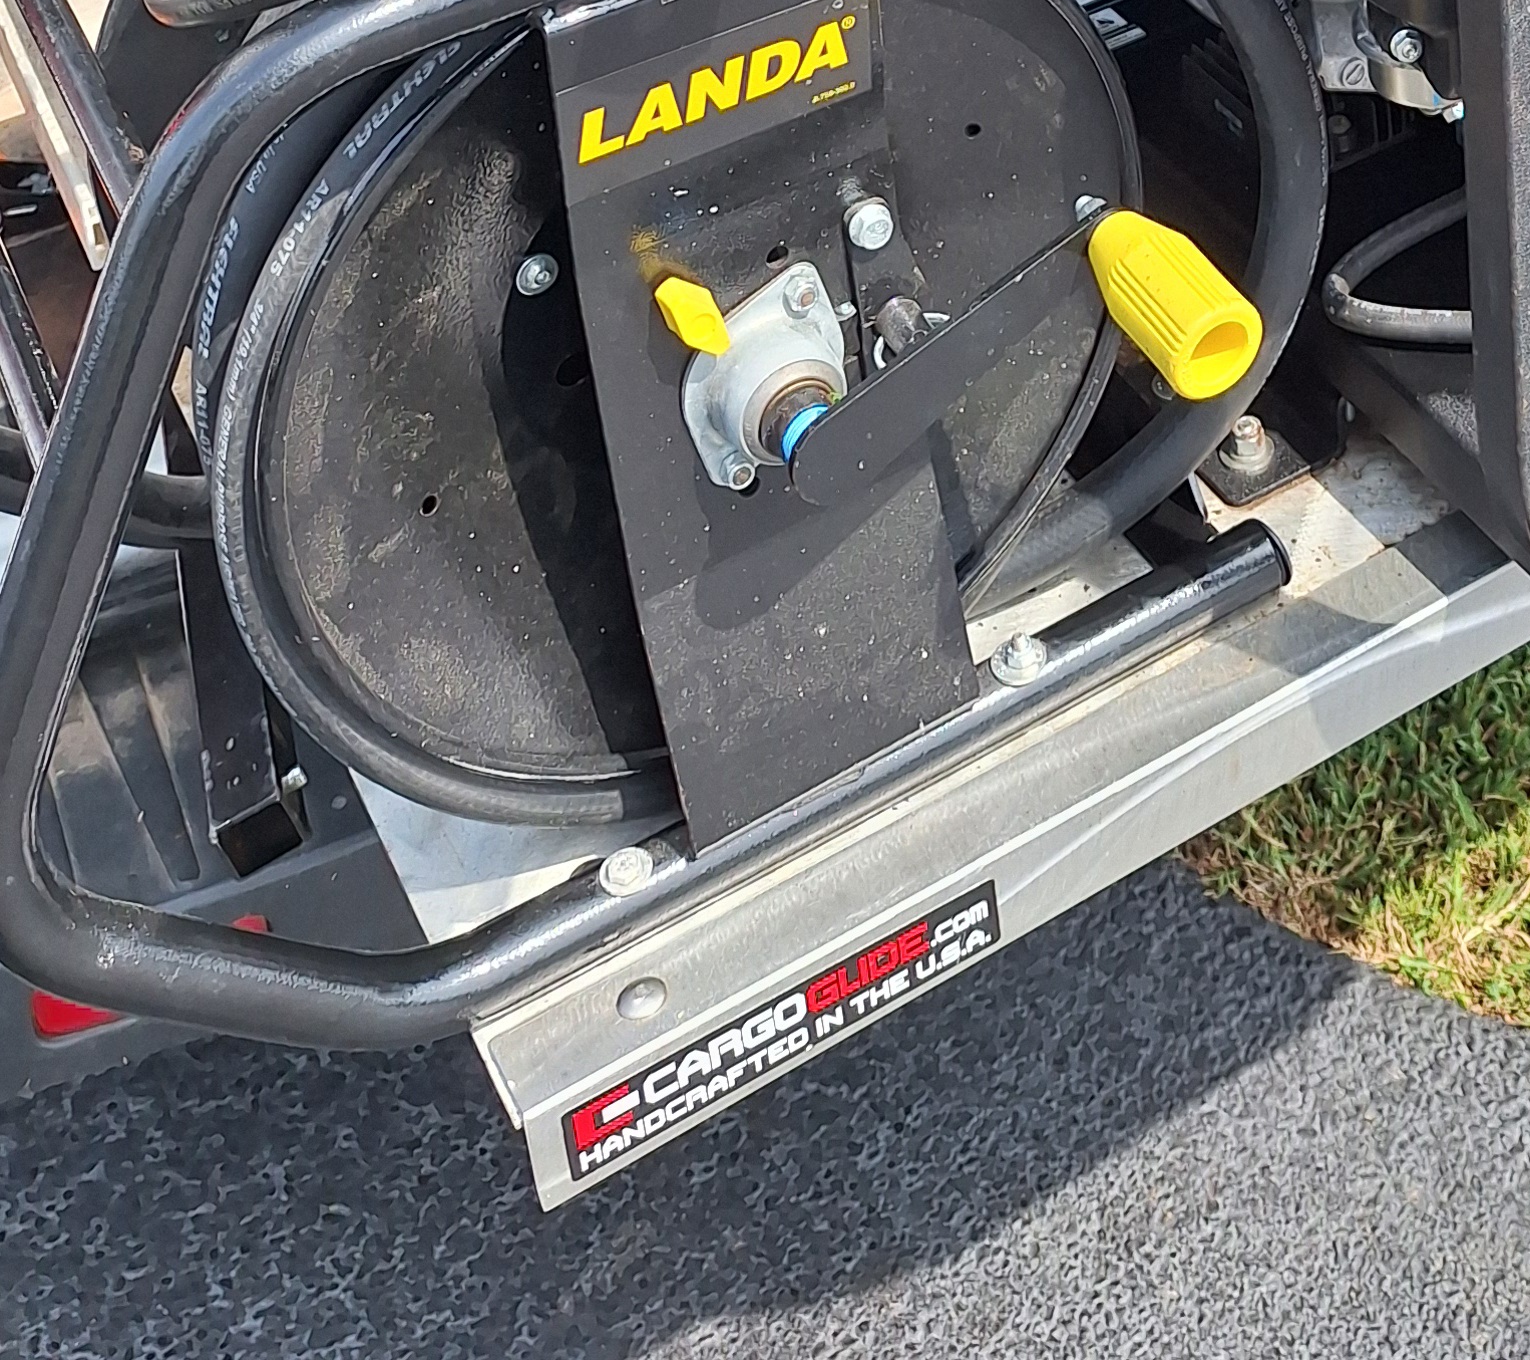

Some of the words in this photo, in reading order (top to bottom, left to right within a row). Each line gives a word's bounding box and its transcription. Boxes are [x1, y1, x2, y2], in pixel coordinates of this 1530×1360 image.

[269, 177, 331, 277] AR11-075
[578, 1026, 811, 1173] HANDCRAFTED
[814, 1005, 845, 1038] IN
[849, 967, 911, 1015] THE
[915, 928, 993, 980] U.S.A.
[643, 899, 990, 1105] CARGOGLIDE.COM
